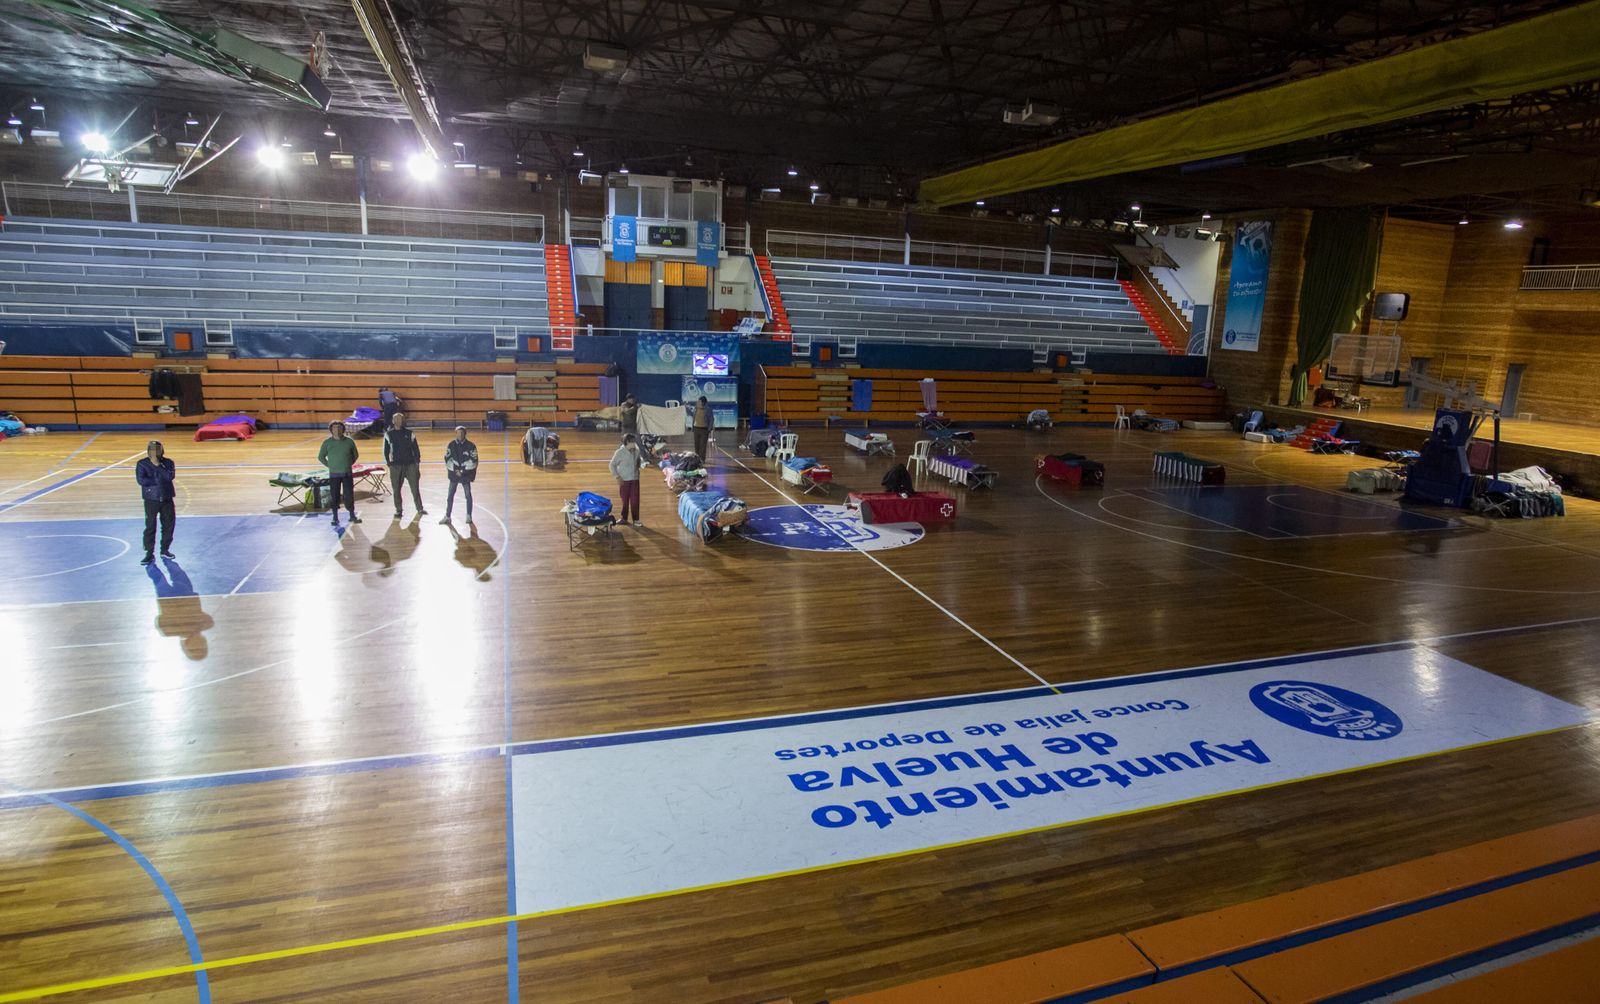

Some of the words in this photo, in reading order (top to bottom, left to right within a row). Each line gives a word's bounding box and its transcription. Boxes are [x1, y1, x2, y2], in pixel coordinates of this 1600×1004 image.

[774, 730, 954, 761] Deportes
[963, 723, 1007, 737] de
[1041, 731, 1119, 756] de
[788, 743, 1037, 792] Huelva
[811, 738, 1272, 830] Ayuntamiento
